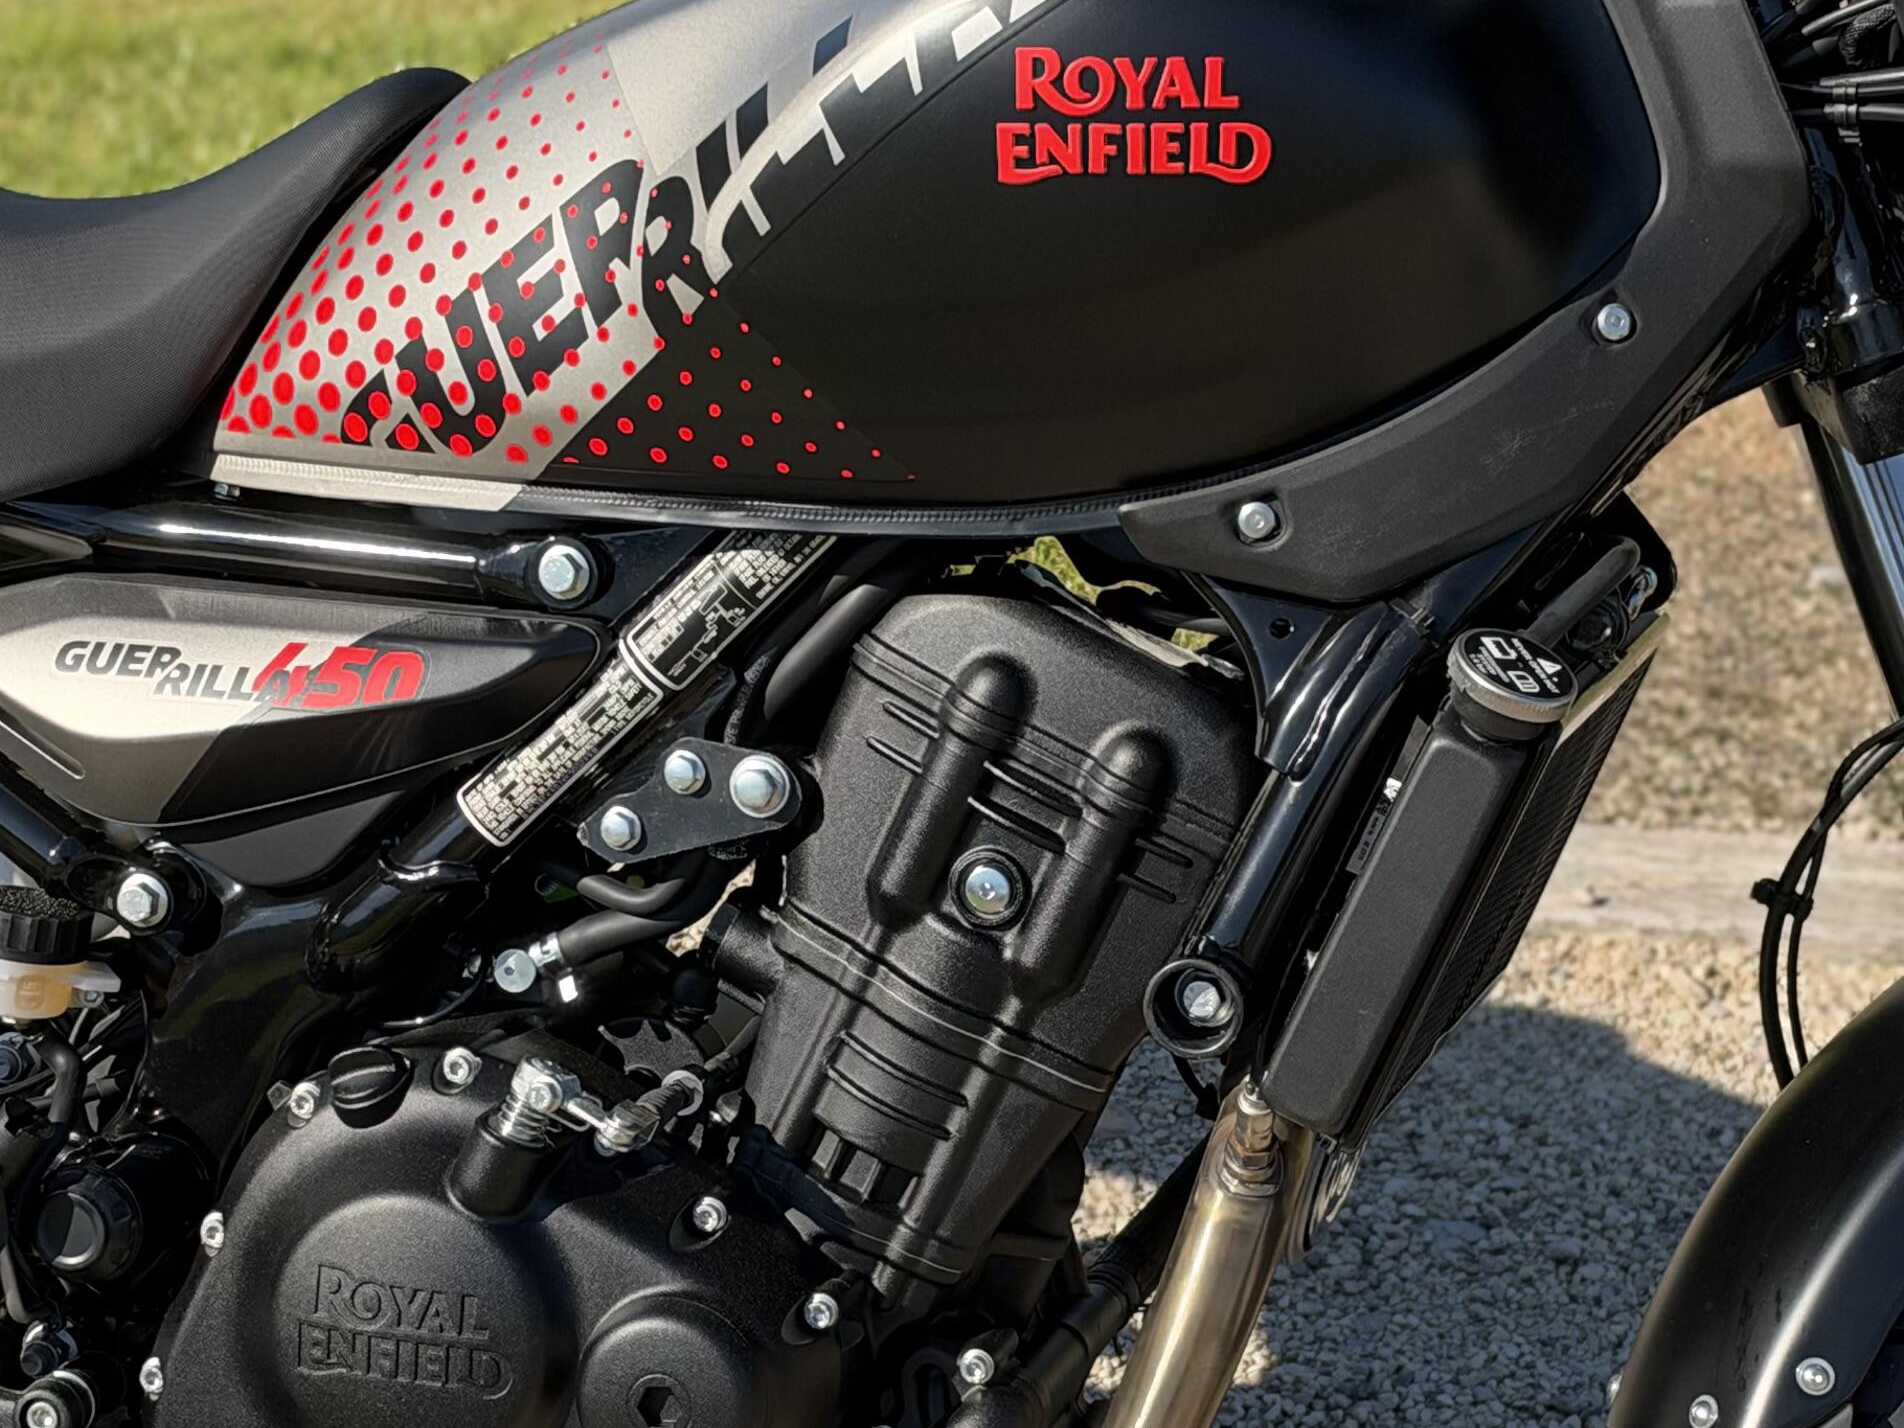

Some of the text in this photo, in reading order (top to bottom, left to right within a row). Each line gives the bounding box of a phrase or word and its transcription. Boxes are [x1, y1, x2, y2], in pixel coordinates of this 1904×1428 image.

[1014, 46, 1240, 118] ROYAL
[995, 122, 1273, 185] ENFIELD
[54, 639, 427, 710] GUERRILLA 450
[313, 1263, 490, 1340] ROYAL
[296, 1320, 515, 1401] ENFIELD
